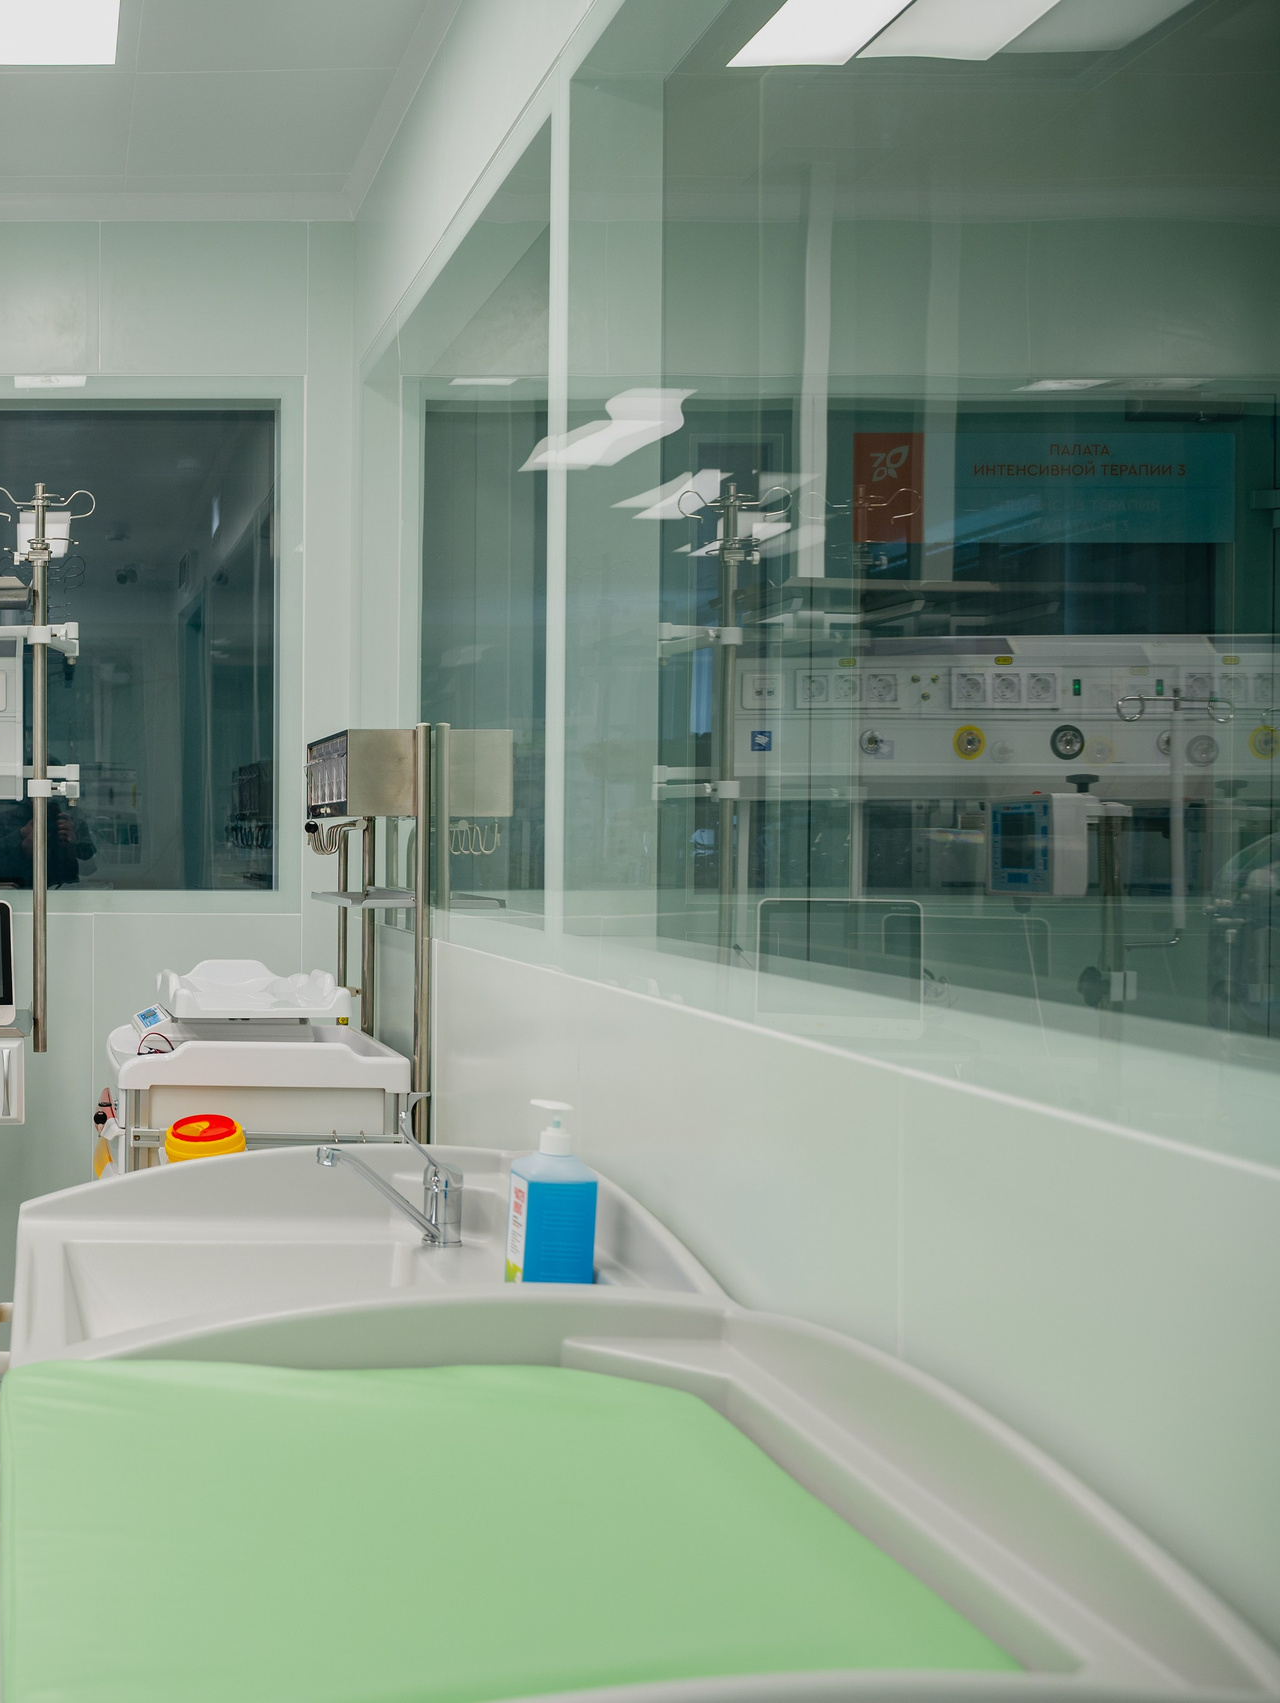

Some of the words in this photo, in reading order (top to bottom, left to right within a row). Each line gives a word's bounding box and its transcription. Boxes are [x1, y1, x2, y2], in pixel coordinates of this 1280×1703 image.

[1049, 443, 1111, 457] ПАЛАТА
[973, 460, 1096, 477] ИНТЕНСИВНОЙ
[1100, 464, 1173, 477] ТЕРАПИИ
[1176, 464, 1187, 477] 3
